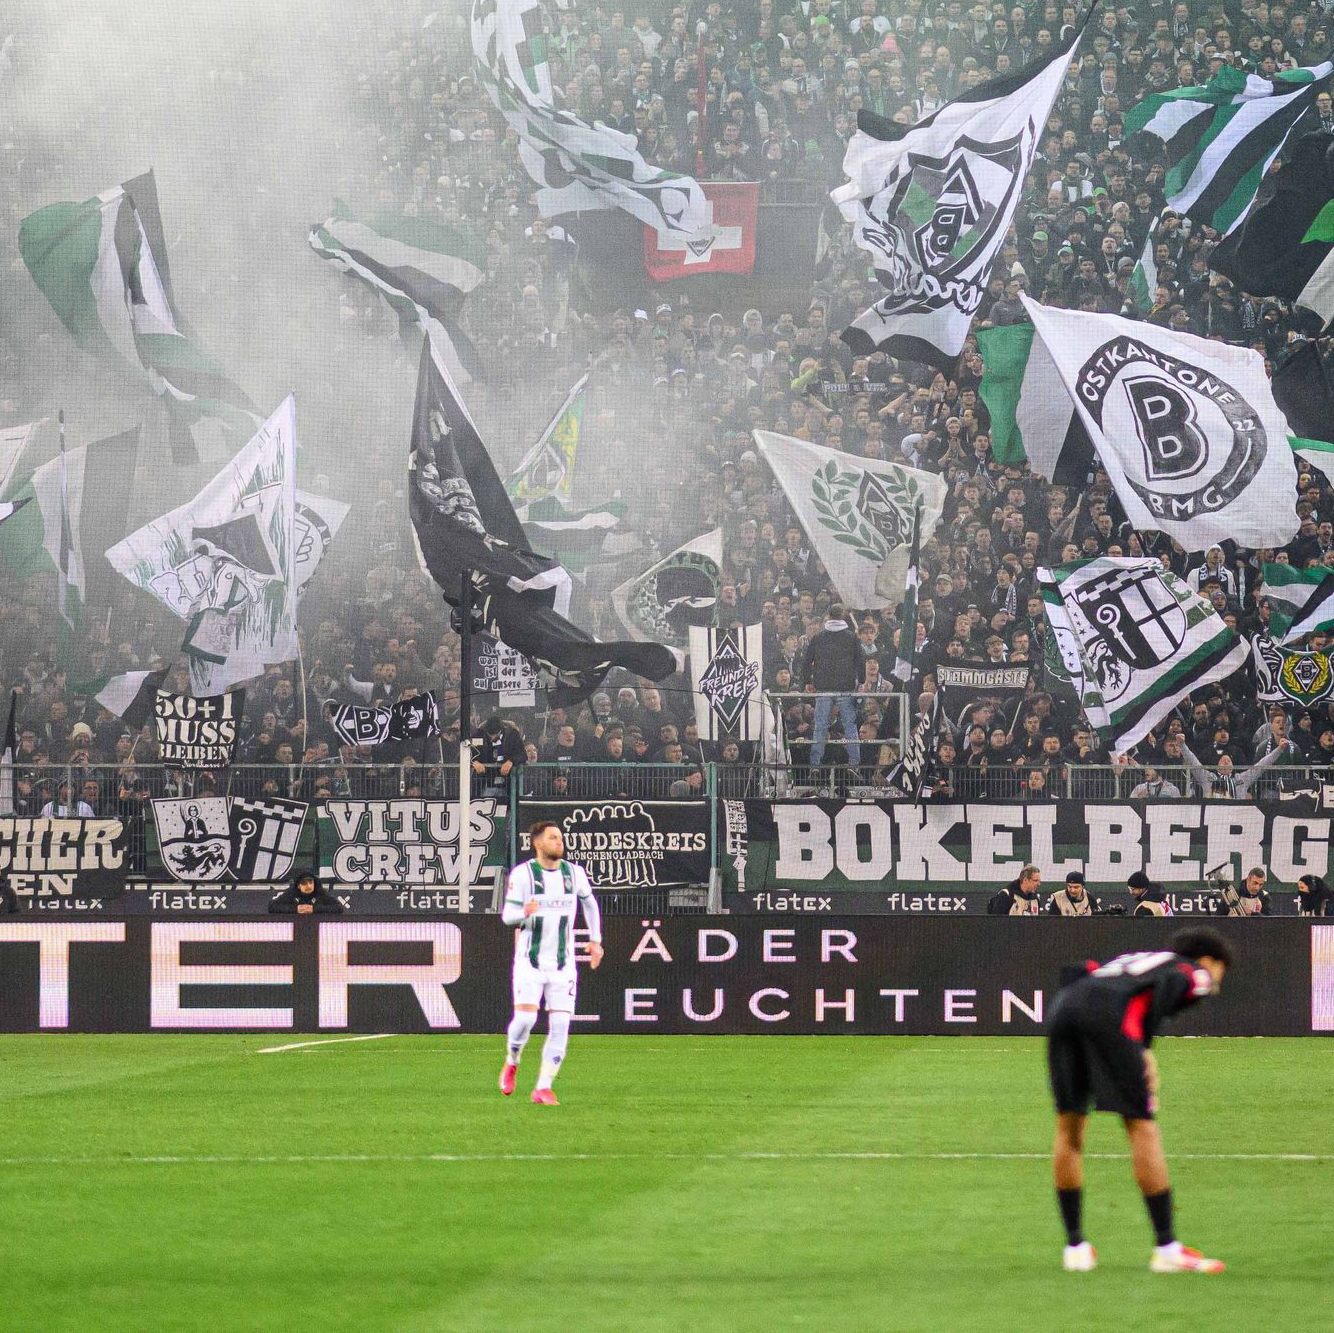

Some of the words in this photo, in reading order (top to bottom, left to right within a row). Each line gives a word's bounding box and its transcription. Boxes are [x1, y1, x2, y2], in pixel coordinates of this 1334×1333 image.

[1083, 341, 1237, 406] OSTKANTONE
[1150, 489, 1225, 517] BMG
[491, 679, 522, 691] unsere
[501, 667, 517, 677] der
[698, 662, 759, 693] FREUNDES
[155, 689, 234, 719] 50+1
[710, 676, 759, 707] KREIS
[155, 716, 236, 745] MUSS
[325, 798, 496, 843] VITUS
[520, 832, 707, 851] FUNDESKREIS
[566, 847, 665, 861] MÖNCHENGLADBACH
[771, 797, 1330, 882] BÖKELBERG
[334, 844, 487, 885] CREW
